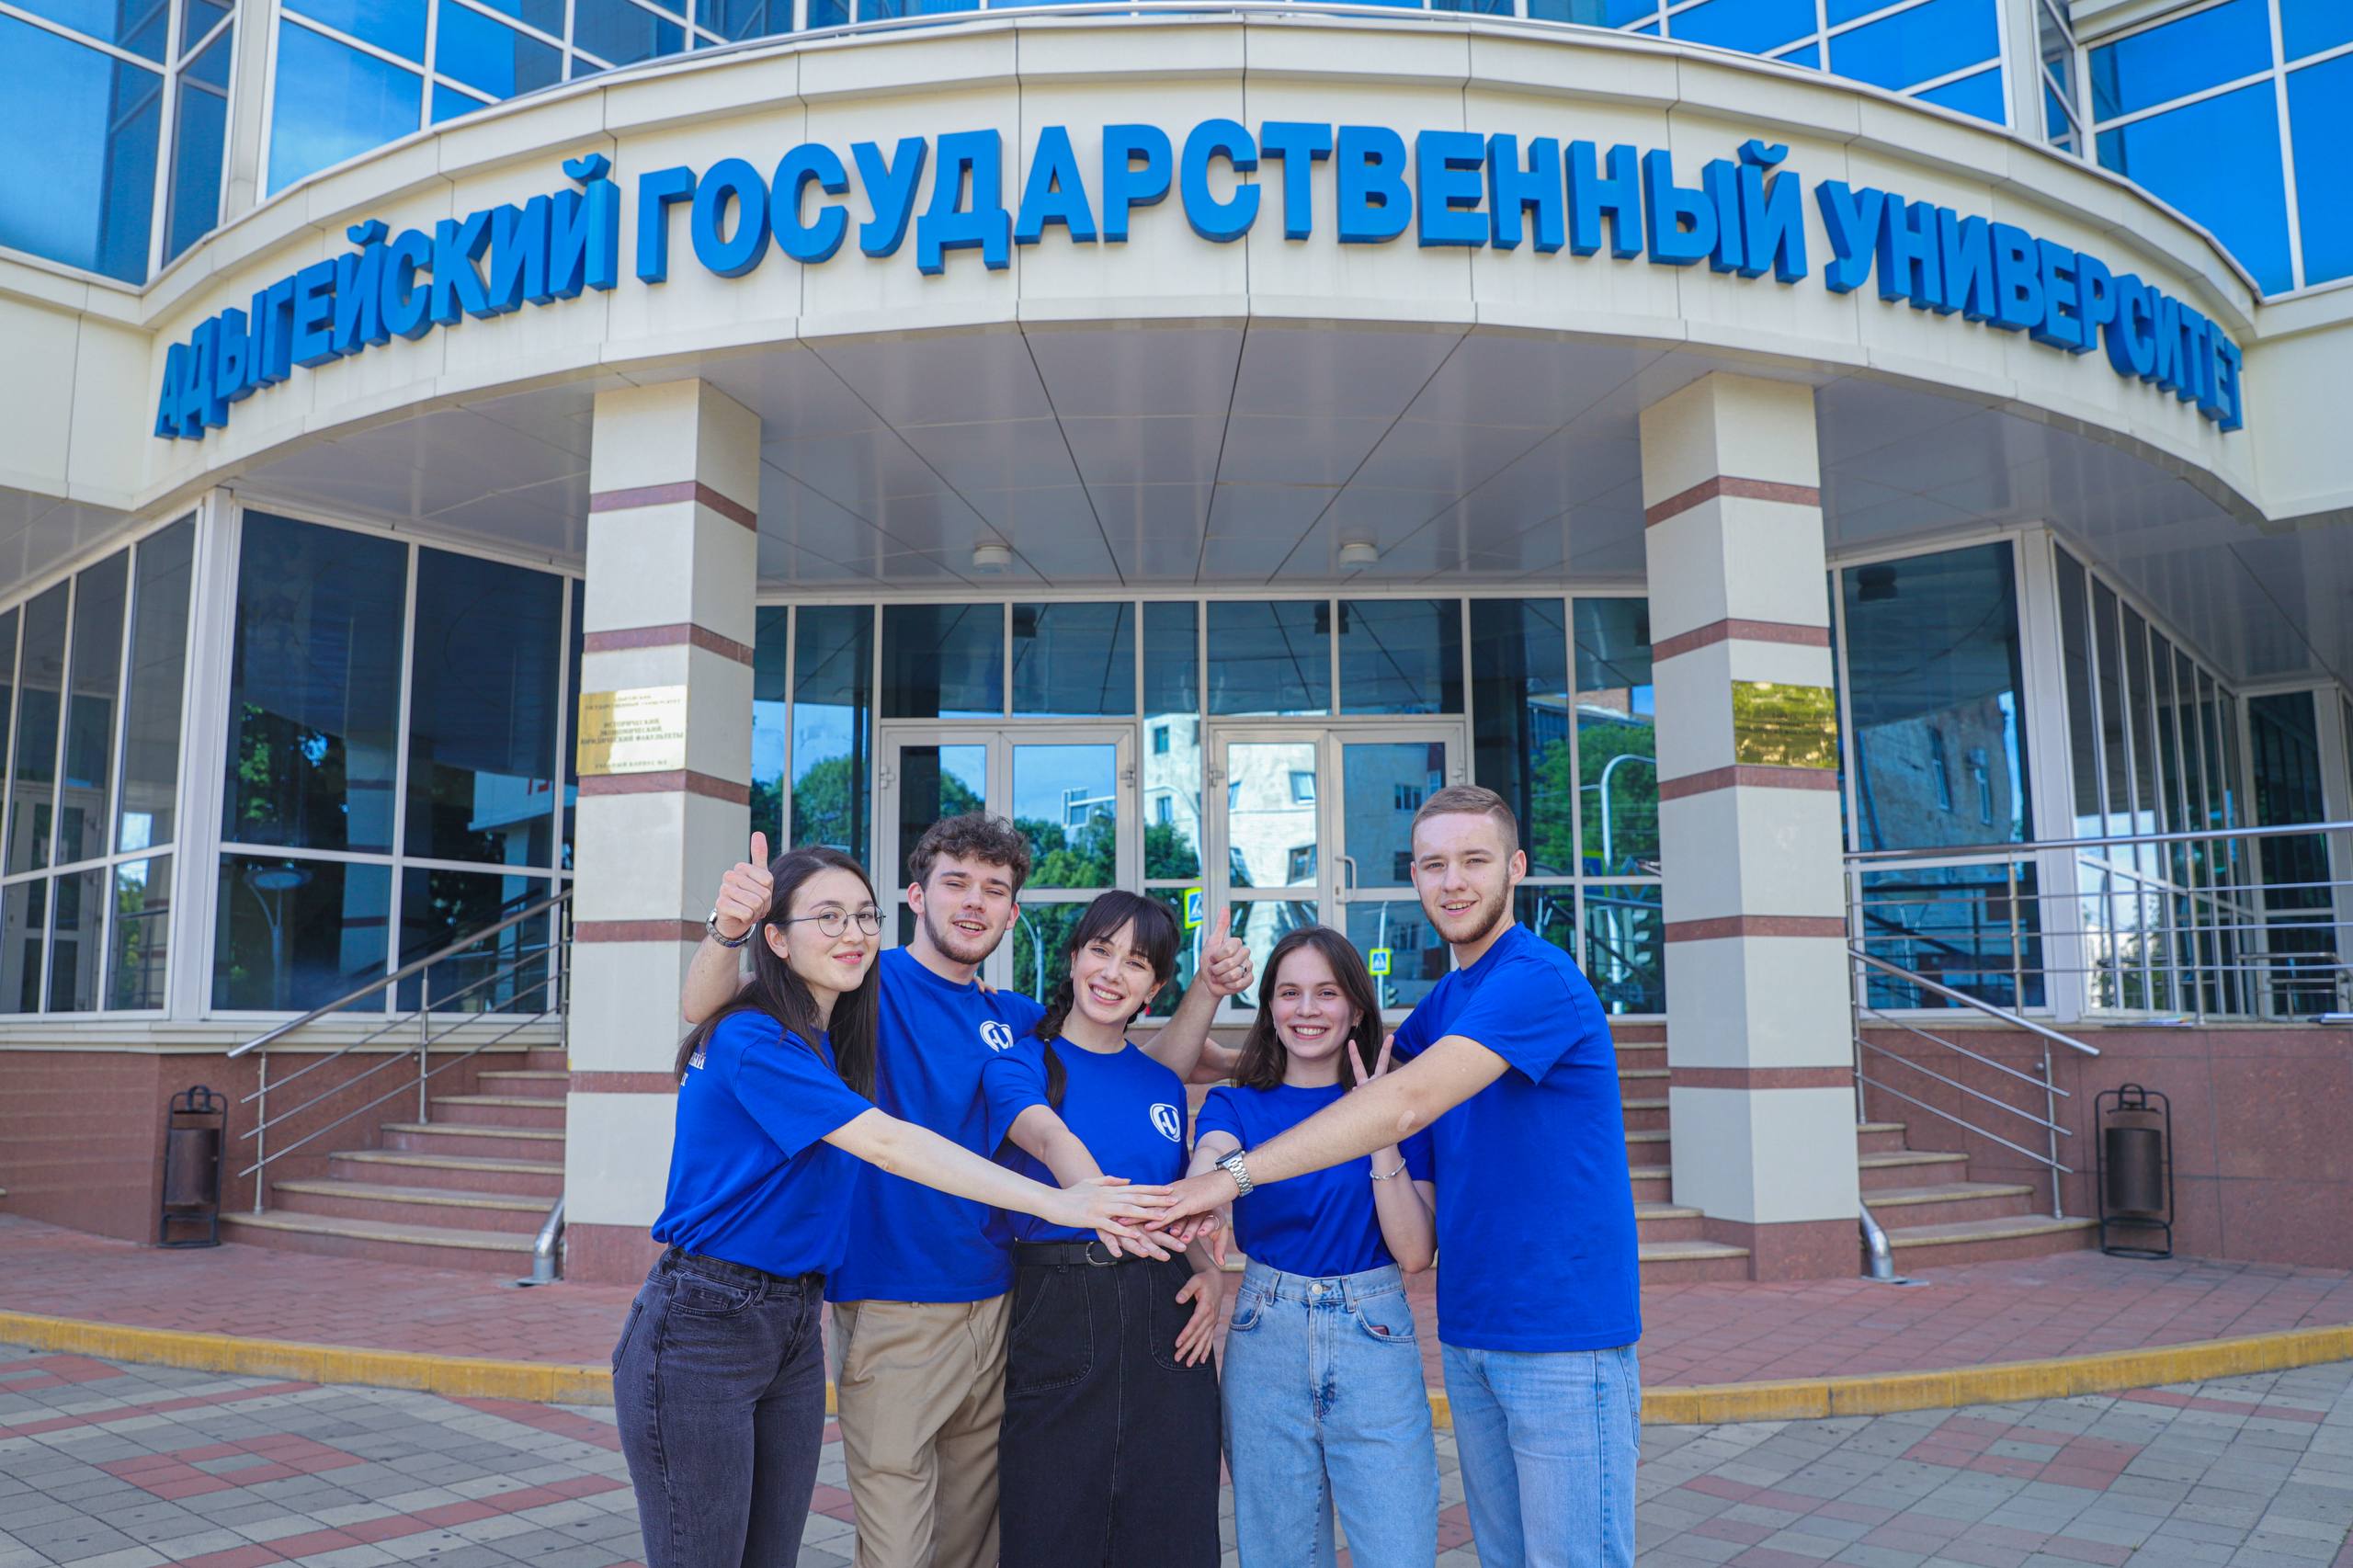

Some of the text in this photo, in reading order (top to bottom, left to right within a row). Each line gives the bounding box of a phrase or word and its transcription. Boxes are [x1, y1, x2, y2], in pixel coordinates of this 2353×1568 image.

[154, 118, 2244, 441] АДЫГЕЙСКИЙ ГОСУДАРСТВЕННЫЙ УНИВЕРСИТЕТ
